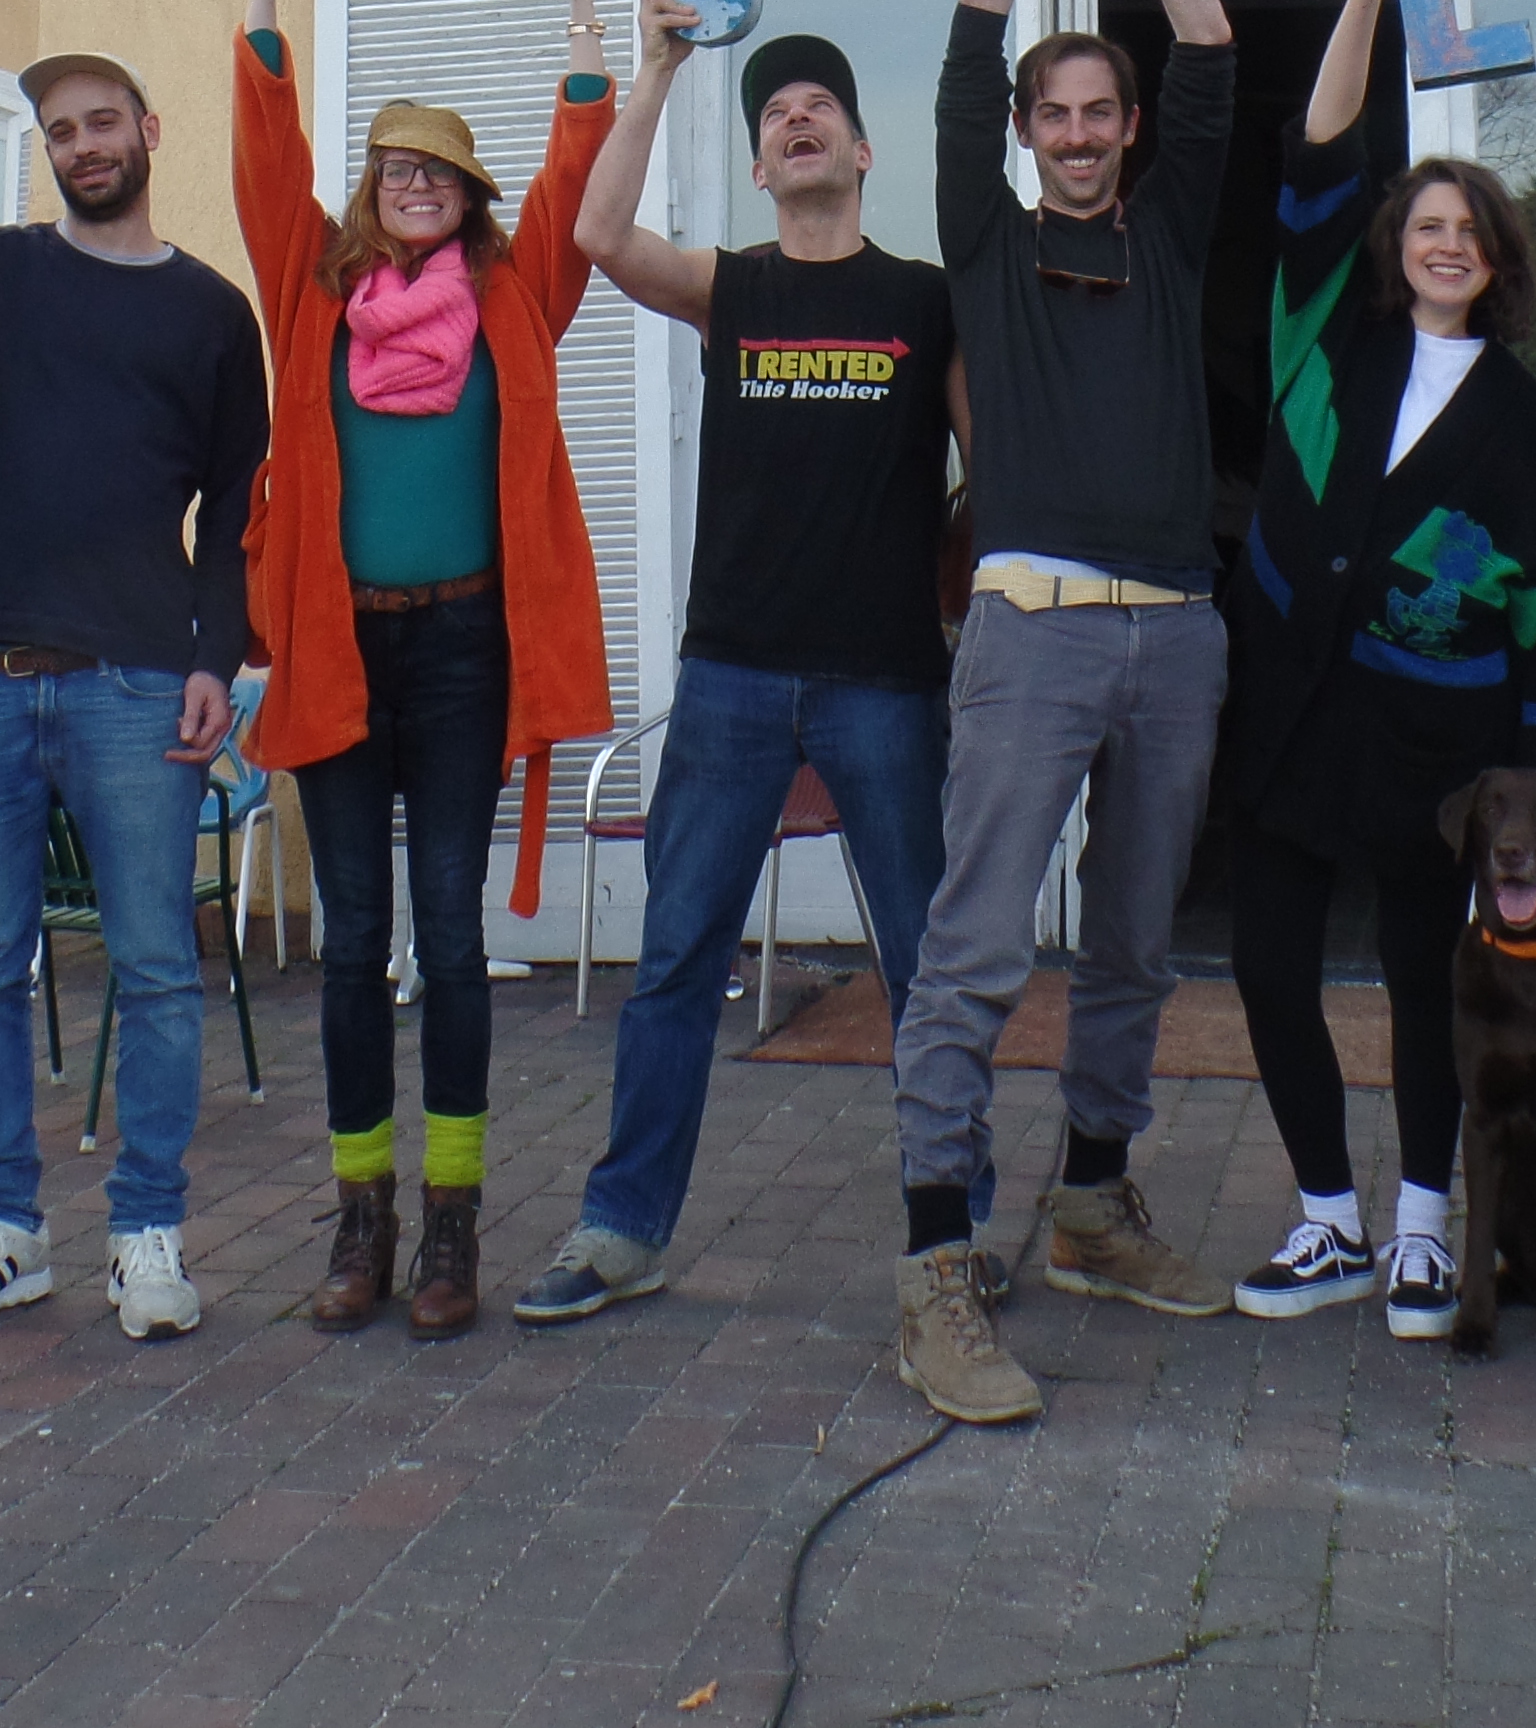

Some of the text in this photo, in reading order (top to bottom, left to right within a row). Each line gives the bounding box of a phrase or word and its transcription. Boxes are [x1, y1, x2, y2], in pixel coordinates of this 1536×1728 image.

[740, 349, 895, 382] I RENTED
[739, 380, 889, 401] This Hooker
